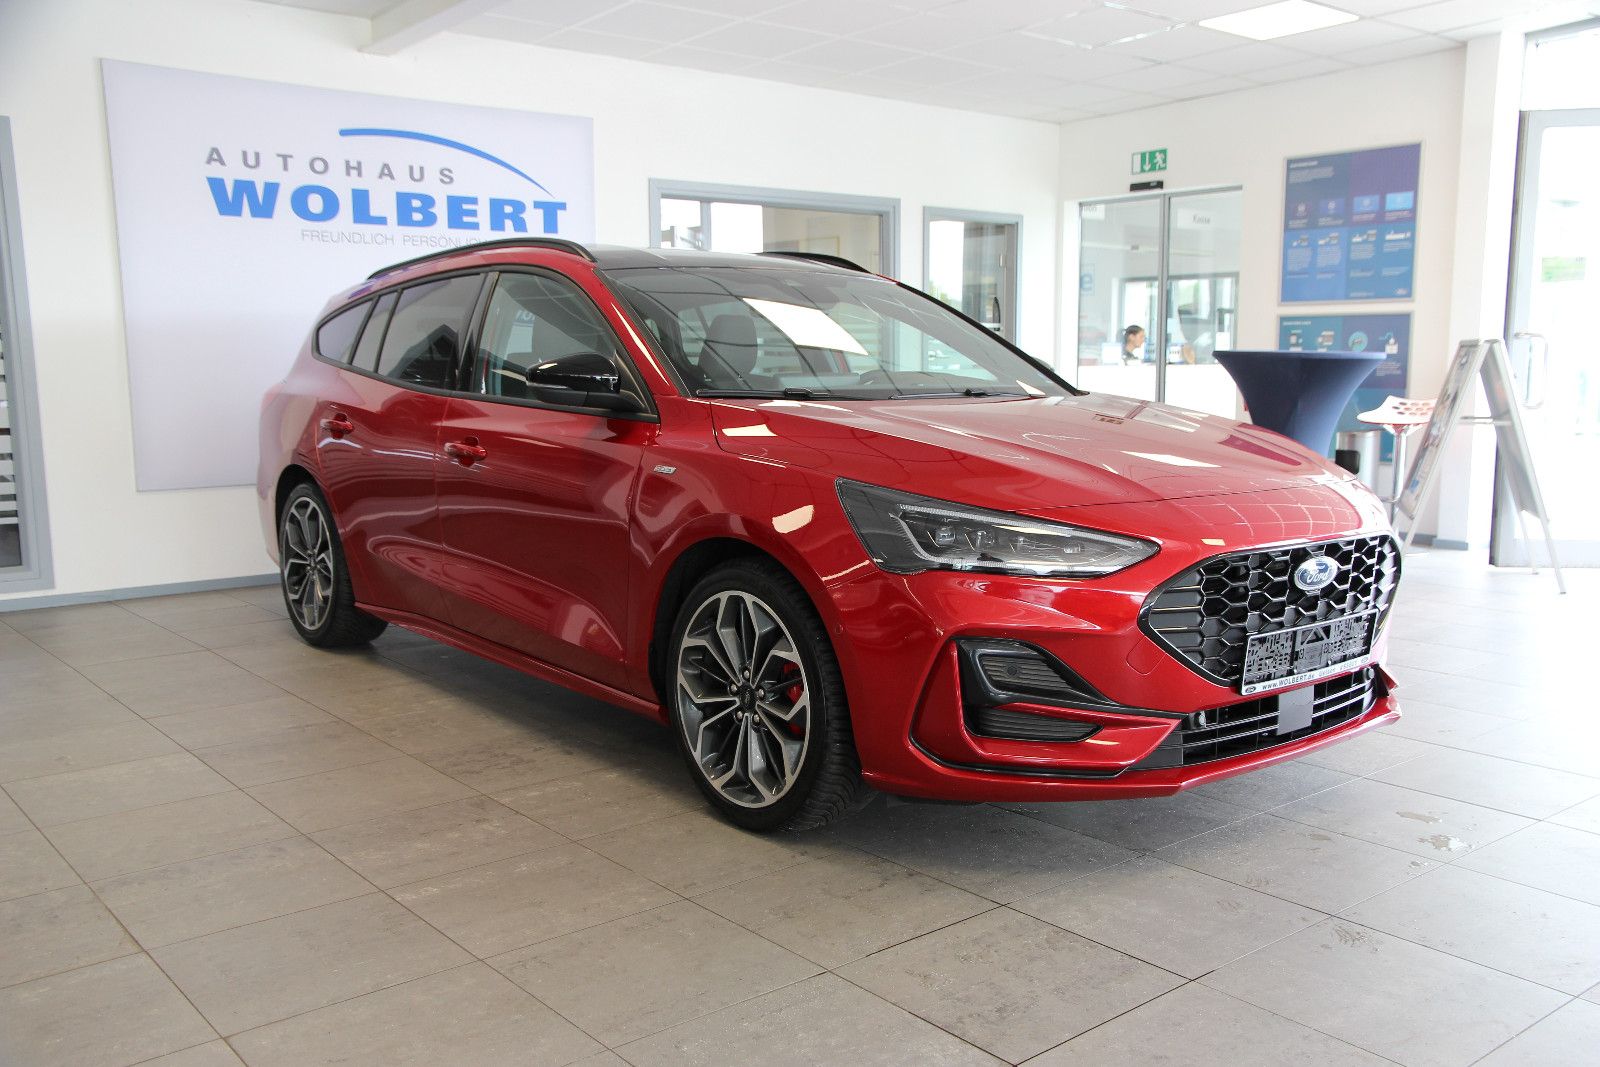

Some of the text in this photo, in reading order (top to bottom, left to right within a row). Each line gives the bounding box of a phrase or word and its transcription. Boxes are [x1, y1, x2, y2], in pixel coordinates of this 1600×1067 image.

[206, 147, 455, 185] AUTOHAUS
[206, 177, 567, 234] WOLBERT
[301, 228, 395, 247] FREUNDLICH
